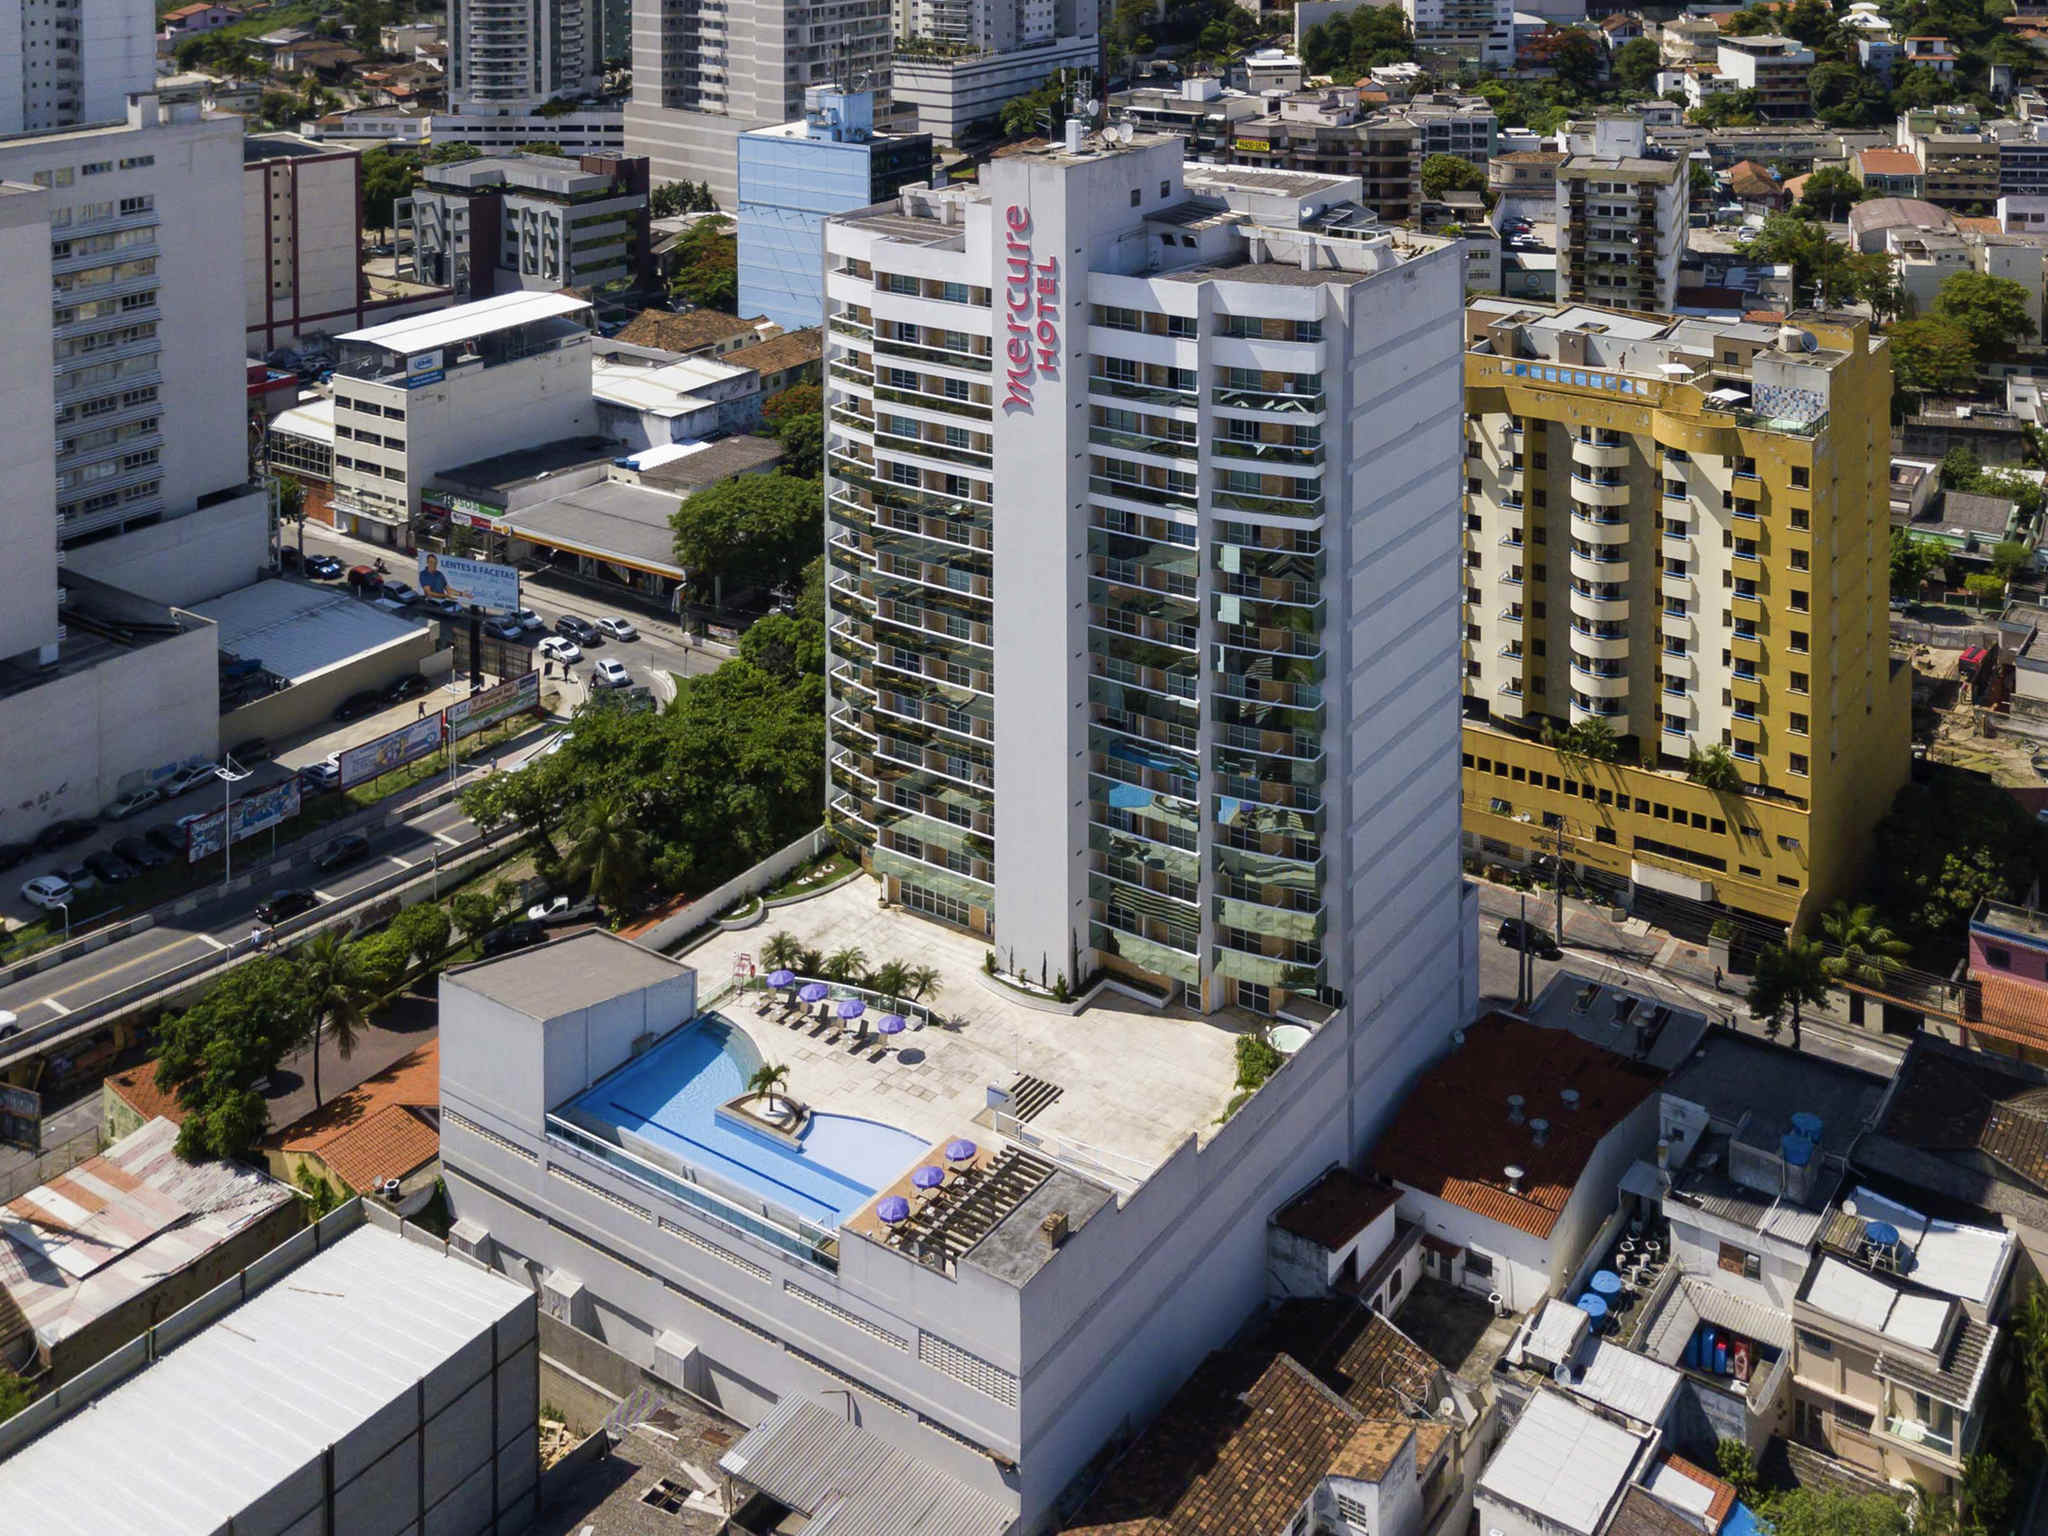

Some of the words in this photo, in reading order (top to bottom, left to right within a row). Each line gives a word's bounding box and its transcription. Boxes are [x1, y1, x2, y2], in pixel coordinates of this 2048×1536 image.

[1037, 256, 1056, 373] HOTEL
[440, 559, 471, 573] LENTES
[479, 566, 515, 580] FACETAS
